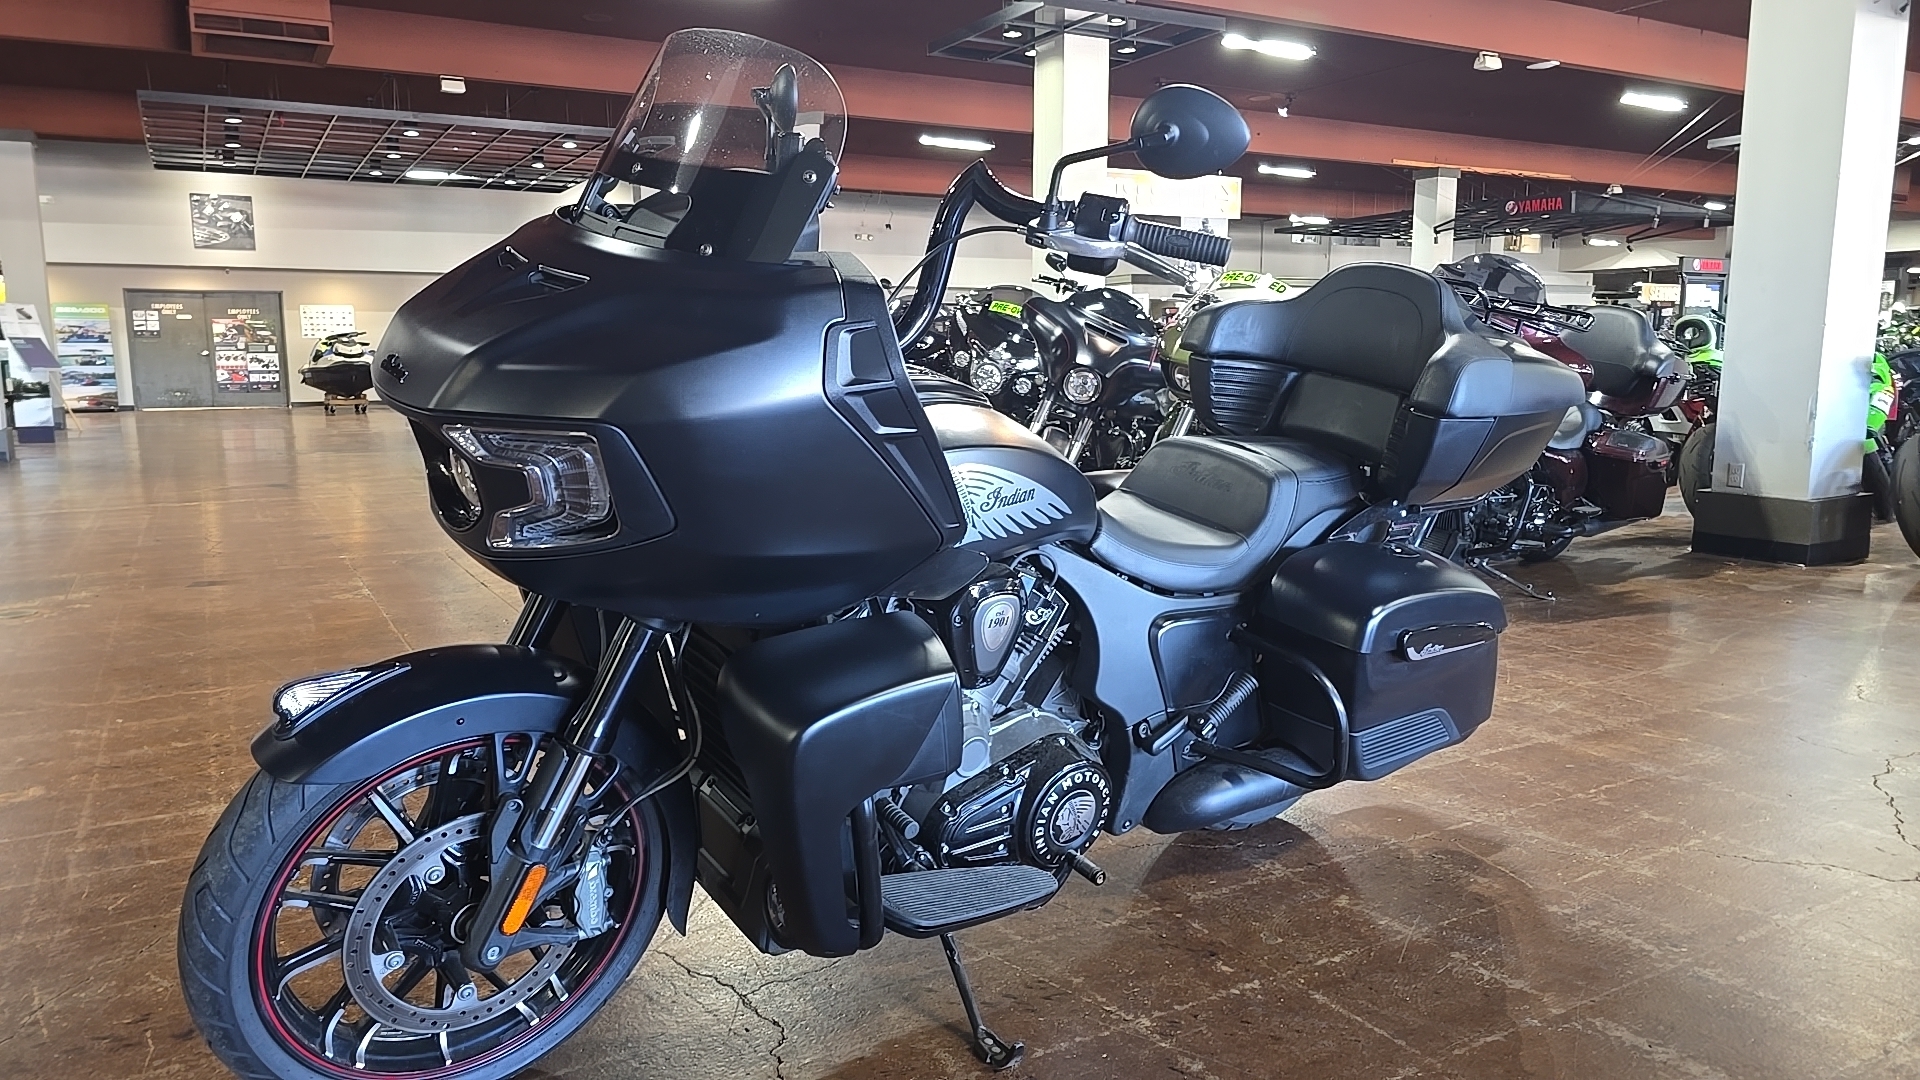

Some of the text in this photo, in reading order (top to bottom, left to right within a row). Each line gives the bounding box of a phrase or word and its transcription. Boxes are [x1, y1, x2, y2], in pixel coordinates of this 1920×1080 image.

[1518, 197, 1563, 213] YAMAHA
[980, 486, 1035, 512] Indian
[988, 616, 1010, 629] 1901
[1035, 791, 1059, 855] INDIAN
[589, 879, 600, 925] brembo
